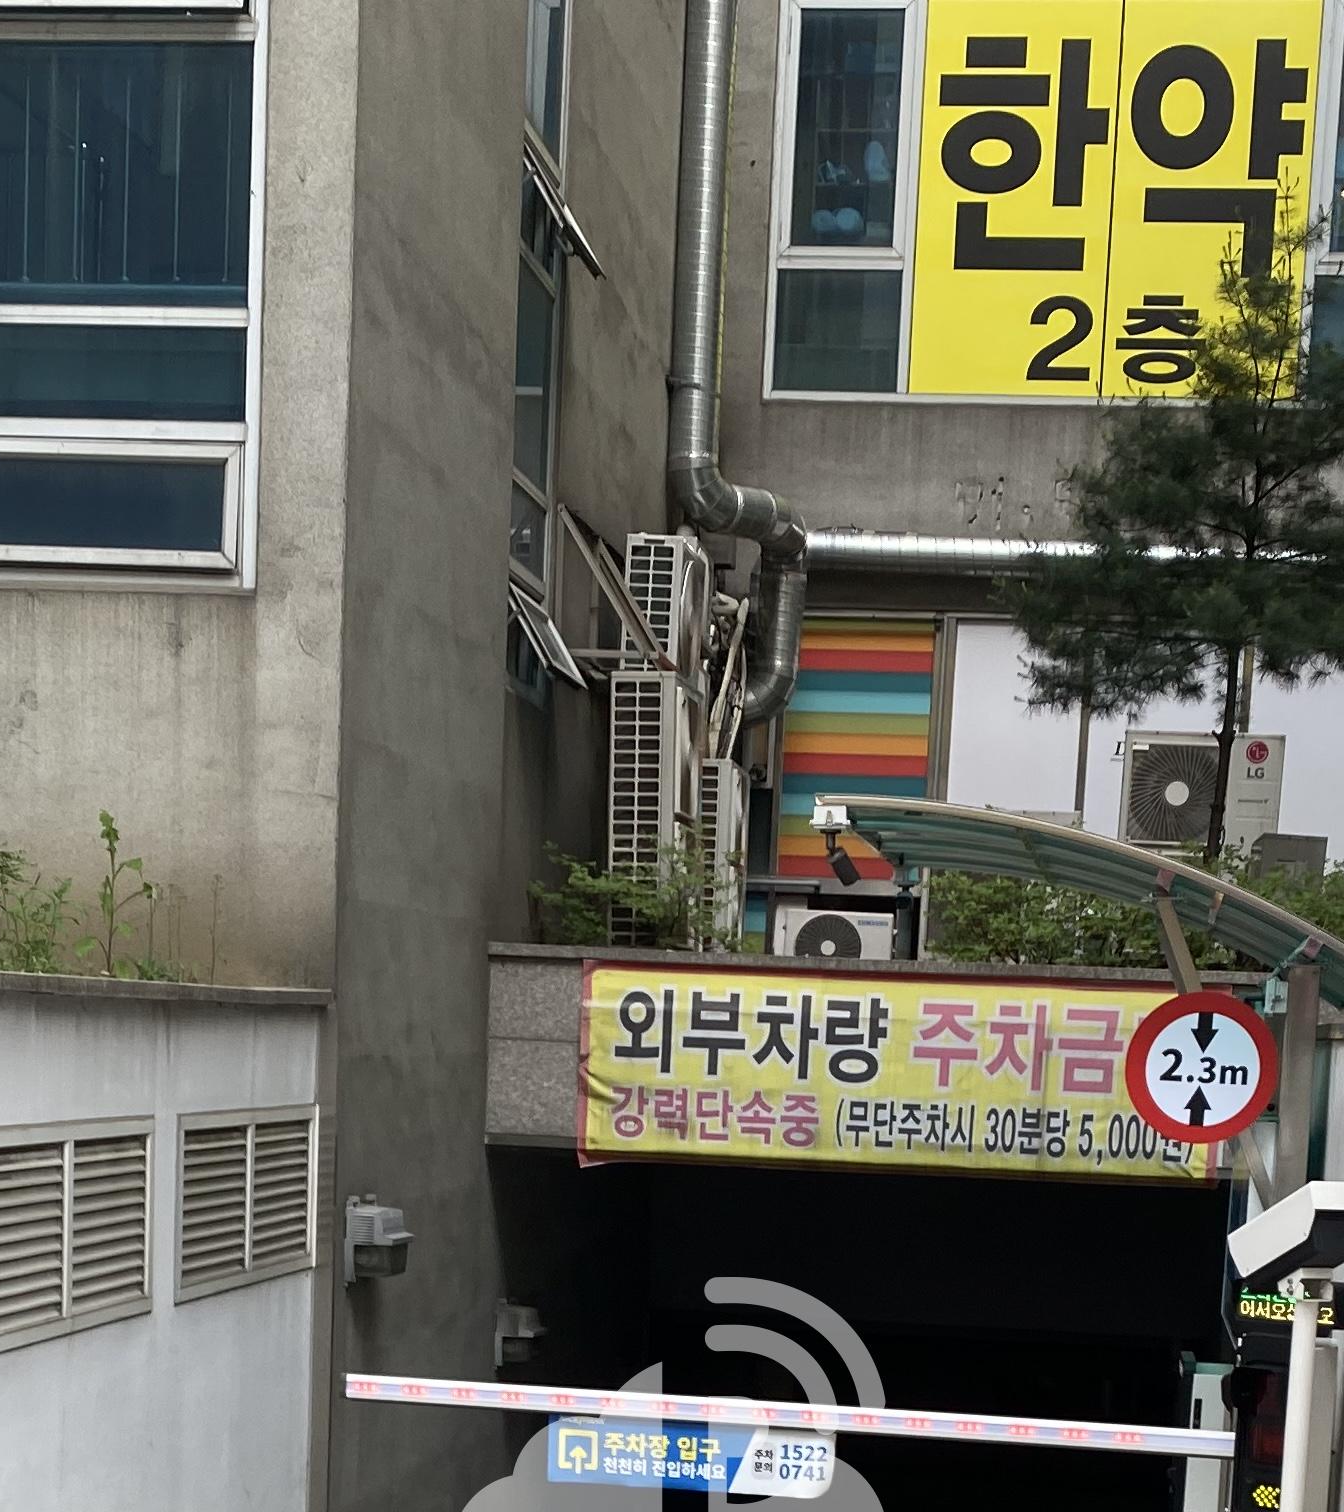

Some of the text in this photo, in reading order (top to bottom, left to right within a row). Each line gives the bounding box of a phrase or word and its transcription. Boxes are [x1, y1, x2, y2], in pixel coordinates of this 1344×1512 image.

[939, 36, 1309, 279] 한약
[1026, 295, 1207, 385] 2층
[1247, 766, 1265, 779] LG
[614, 989, 1144, 1095] 외부차량 주차금
[1159, 1048, 1248, 1086] 2.3m
[611, 1085, 820, 1148] 강력단속중
[836, 1098, 976, 1153] (무단주차시
[984, 1107, 1071, 1159] 30분당
[604, 1432, 721, 1462] 주차장 입구
[780, 1444, 828, 1462] 1522
[603, 1457, 727, 1481] 천천히 진입하세요
